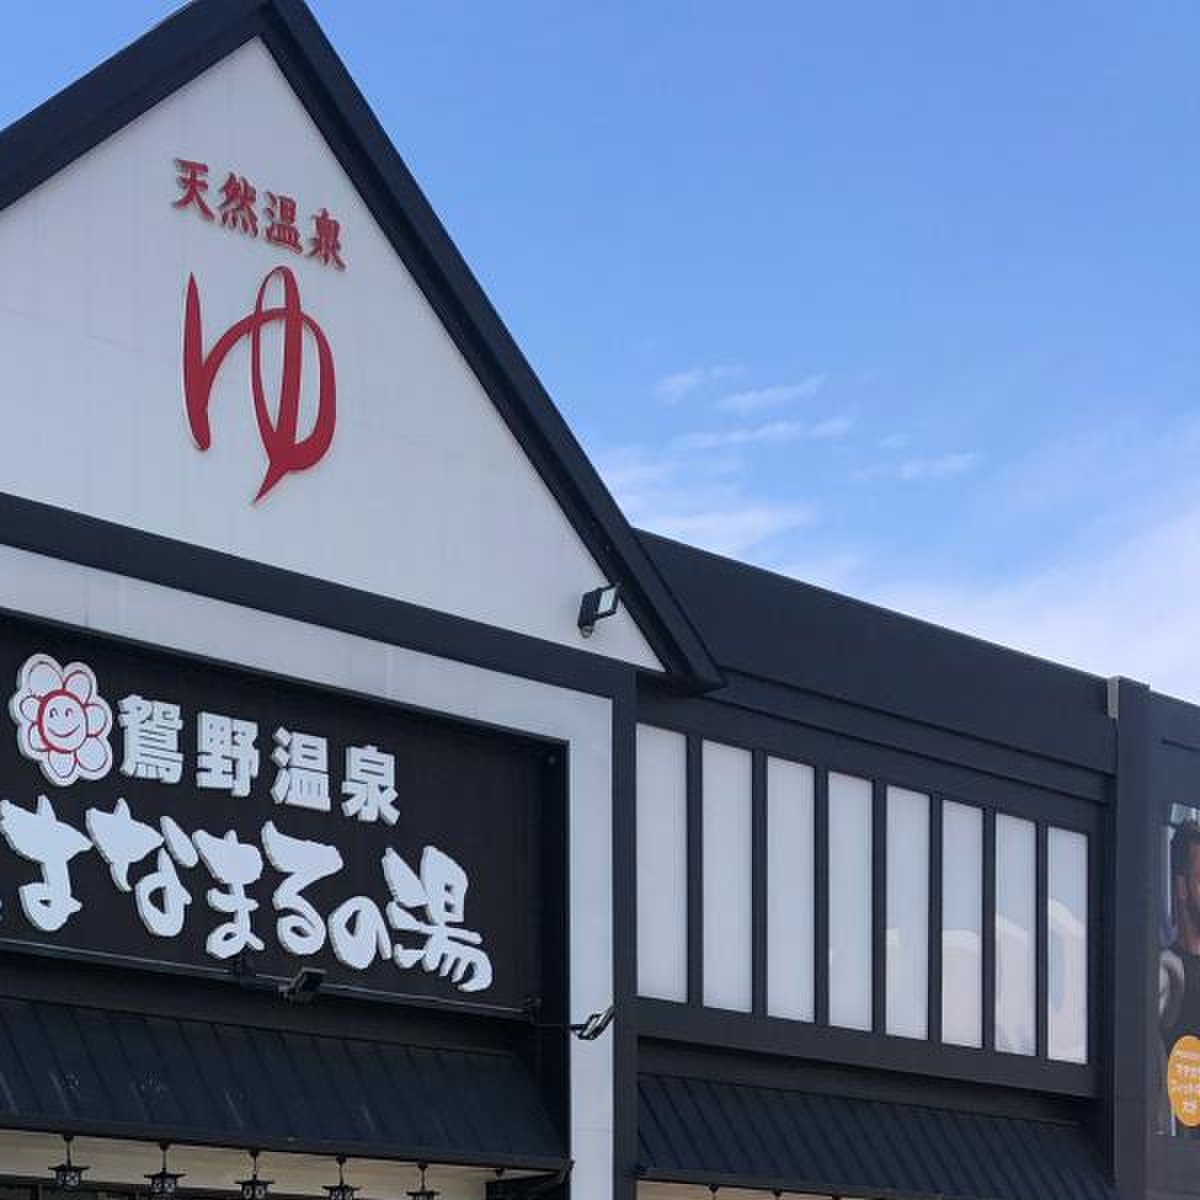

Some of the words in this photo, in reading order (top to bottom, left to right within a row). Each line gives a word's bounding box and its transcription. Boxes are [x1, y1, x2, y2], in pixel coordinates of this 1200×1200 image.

[173, 158, 347, 271] 天然温泉
[182, 265, 337, 506] ゆ
[118, 694, 400, 825] 鴛野温泉
